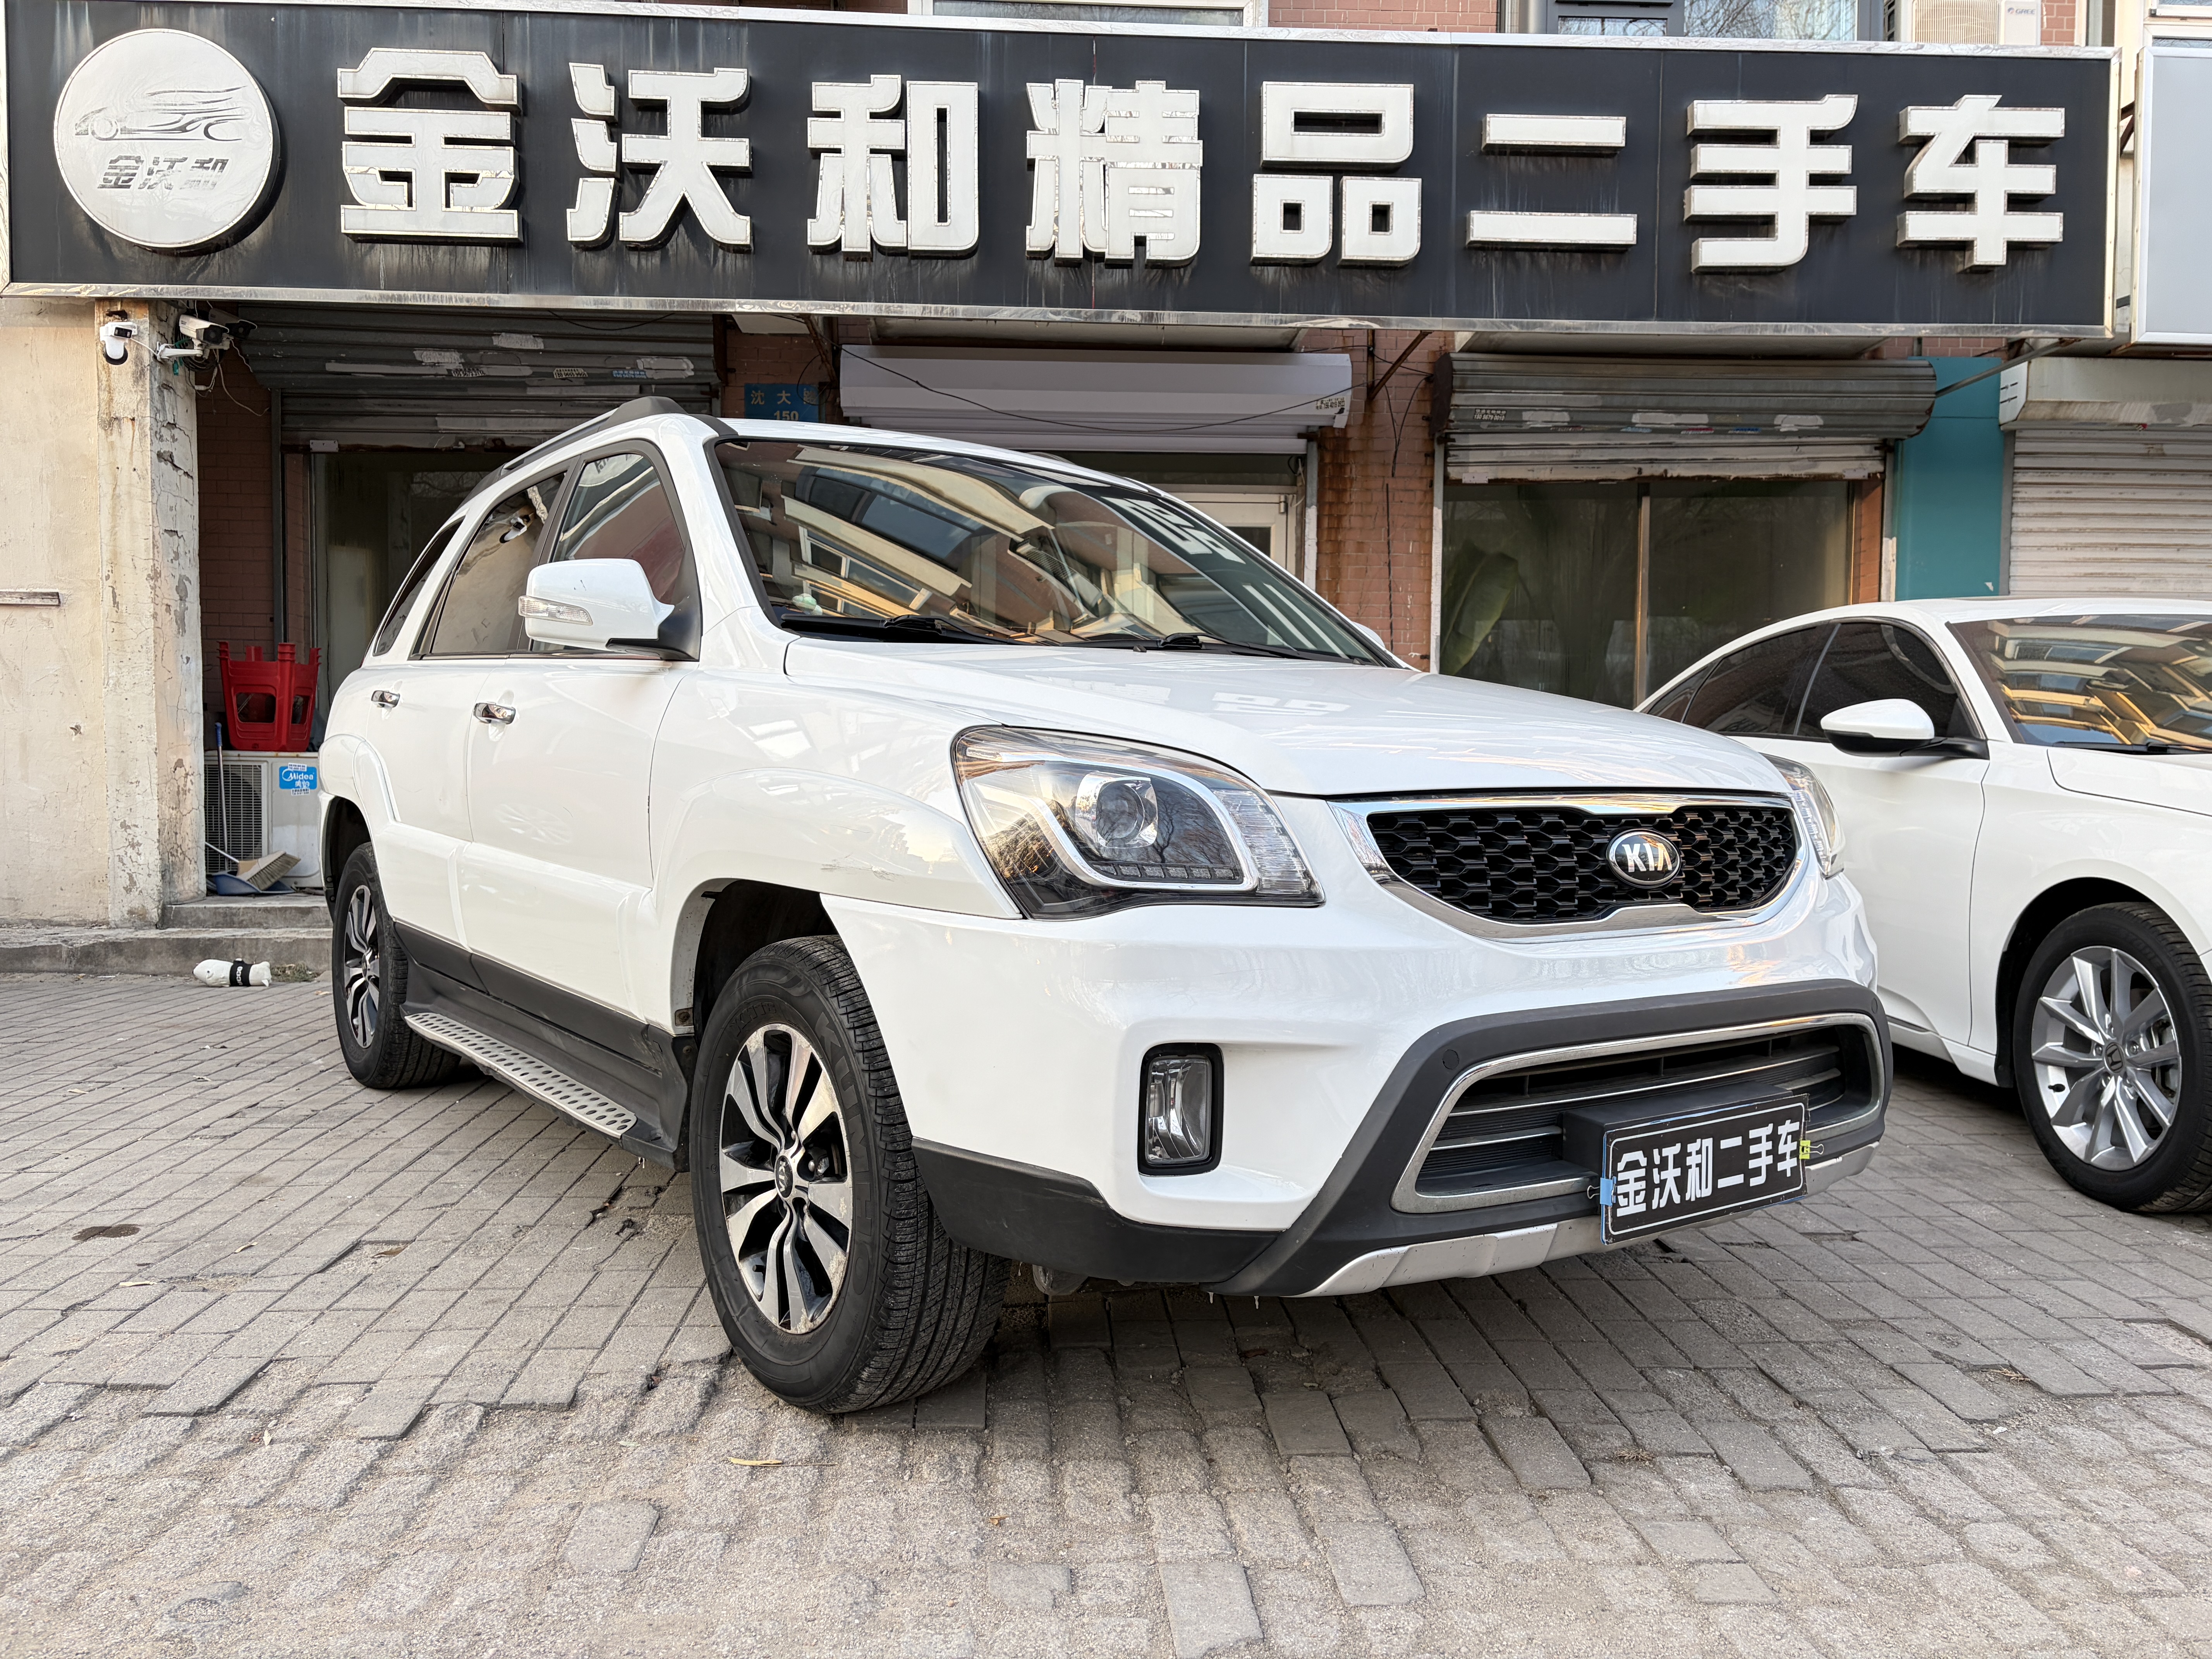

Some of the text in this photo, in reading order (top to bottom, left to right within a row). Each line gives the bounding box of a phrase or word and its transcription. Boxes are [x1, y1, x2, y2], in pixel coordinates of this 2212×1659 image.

[337, 48, 2065, 269] 金沃和精品二手车
[774, 410, 799, 421] 150
[282, 770, 314, 781] Midea
[1622, 843, 1673, 872] KIA
[814, 1012, 872, 1295] KUMHO
[1616, 1119, 1800, 1217] 金沃和二手车
